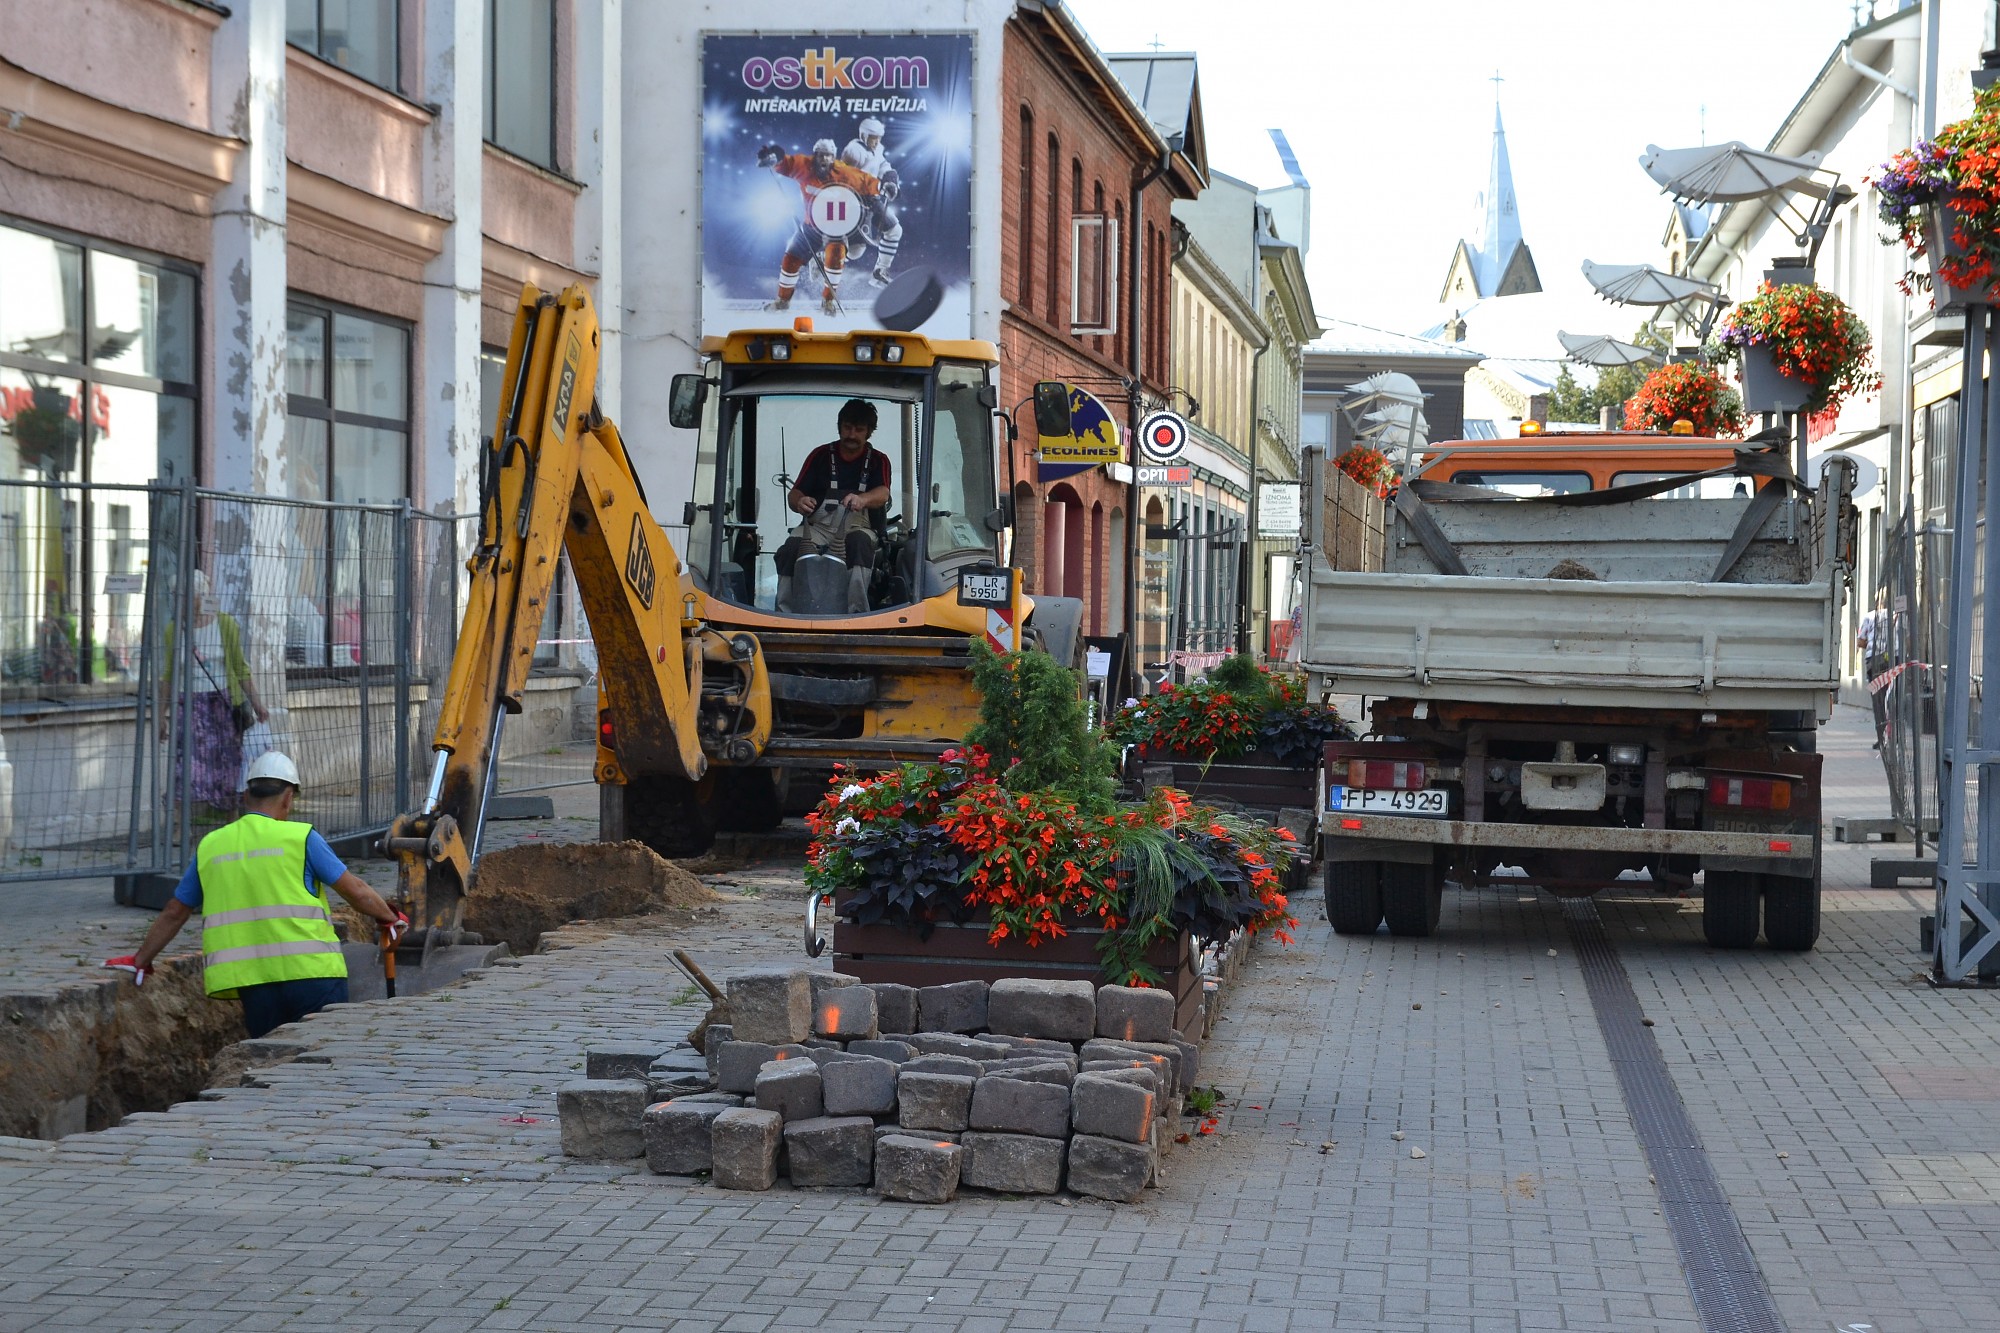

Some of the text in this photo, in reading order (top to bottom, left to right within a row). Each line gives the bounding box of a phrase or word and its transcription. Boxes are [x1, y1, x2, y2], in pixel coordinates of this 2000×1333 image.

[742, 47, 930, 90] ostkom
[745, 96, 928, 113] INTERAKTĪVĀ TELEVĪZIJA
[1138, 468, 1190, 481] OPTIBET
[629, 524, 654, 605] JCB
[968, 576, 998, 588] T LR
[970, 587, 998, 598] 5950
[1346, 790, 1443, 811] FP-4929
